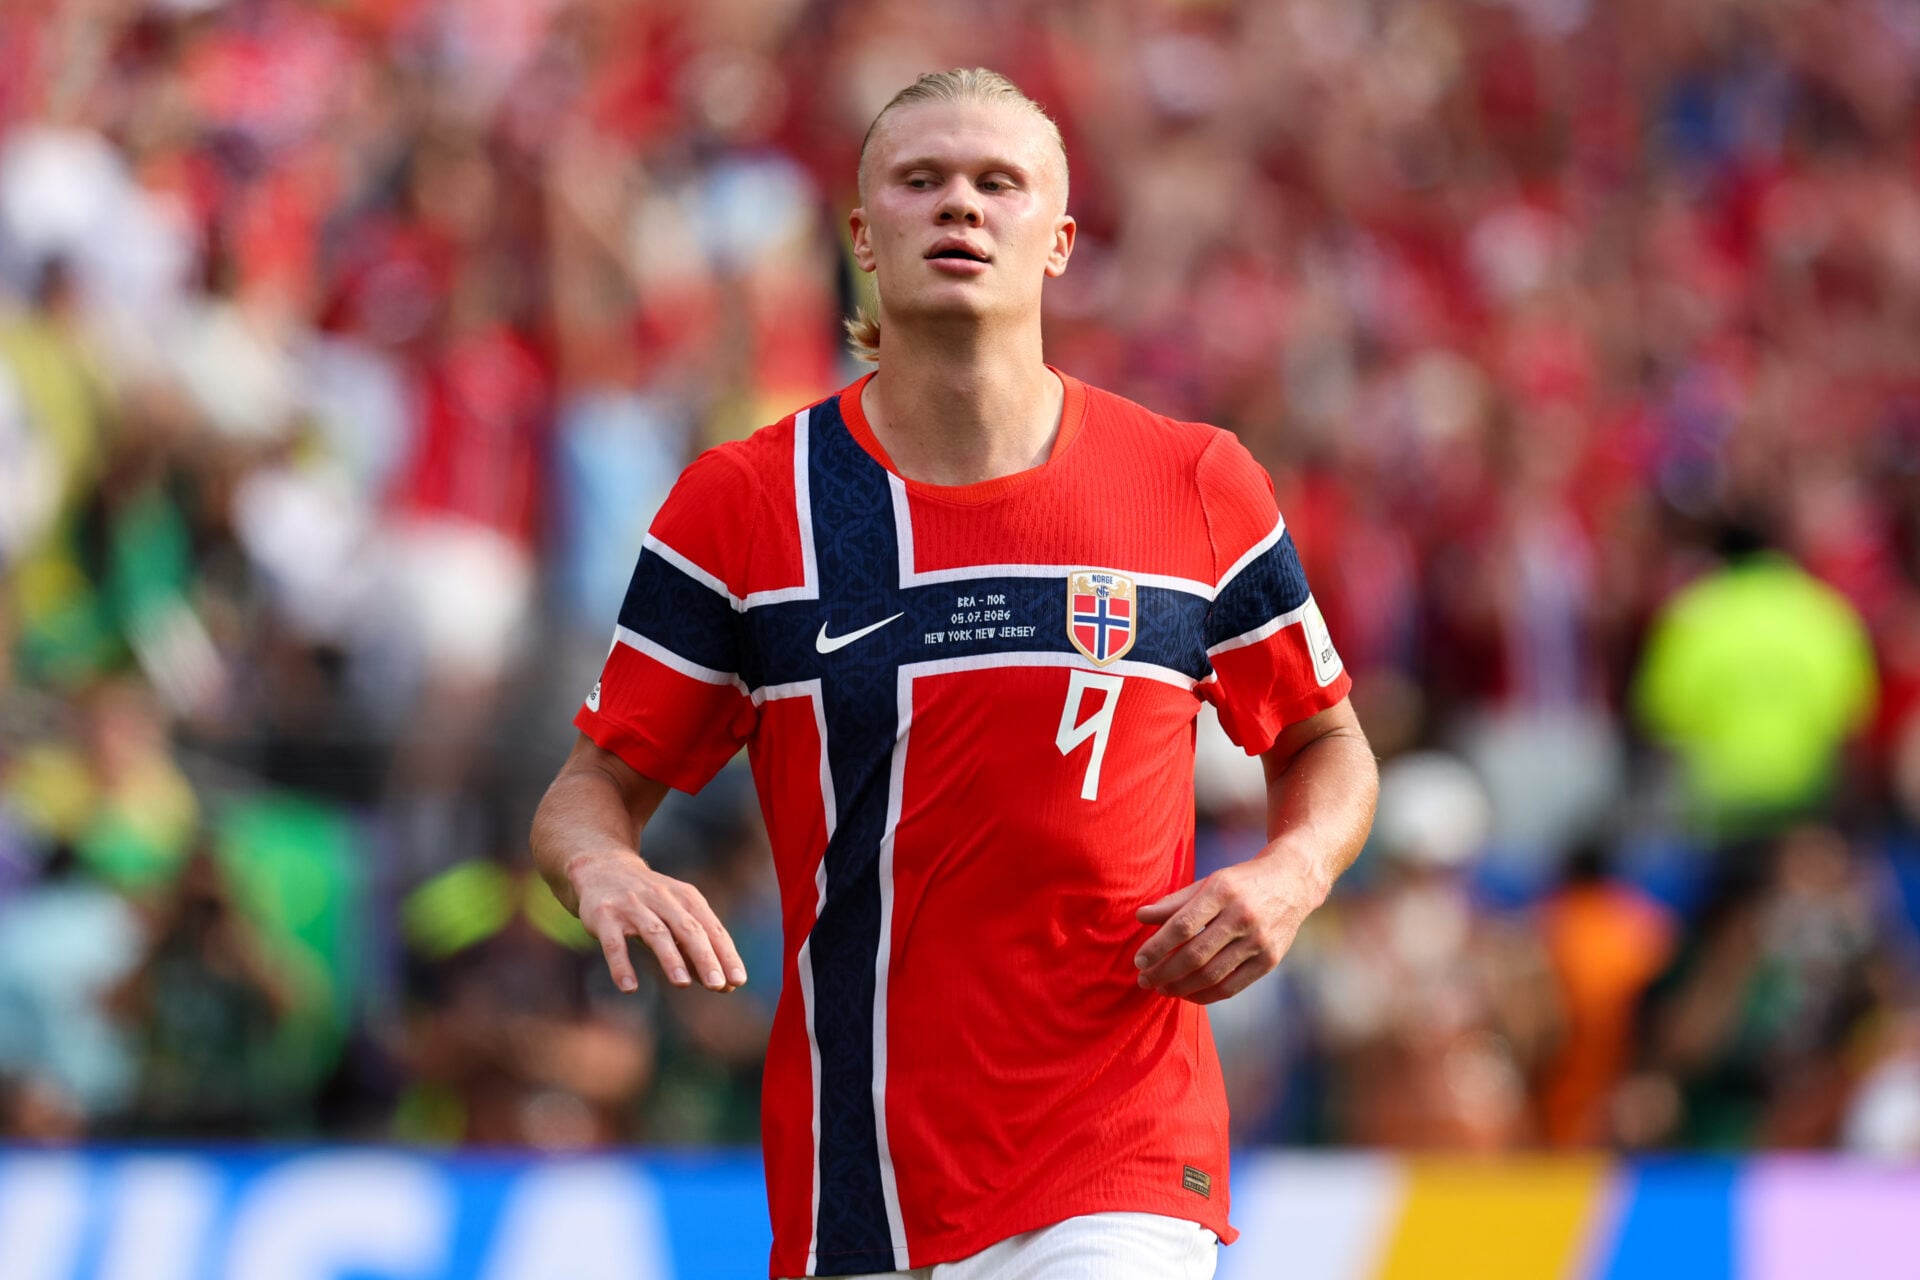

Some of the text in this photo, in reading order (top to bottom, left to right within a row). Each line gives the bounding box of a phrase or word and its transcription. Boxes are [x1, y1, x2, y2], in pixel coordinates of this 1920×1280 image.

[1092, 574, 1113, 584] NORGE
[957, 596, 976, 608] BRA
[987, 594, 1006, 606] NOR
[951, 610, 1011, 624] 05.07.2026
[924, 626, 1036, 644] NEW YORK NEW JERSEY
[1055, 668, 1125, 802] 9
